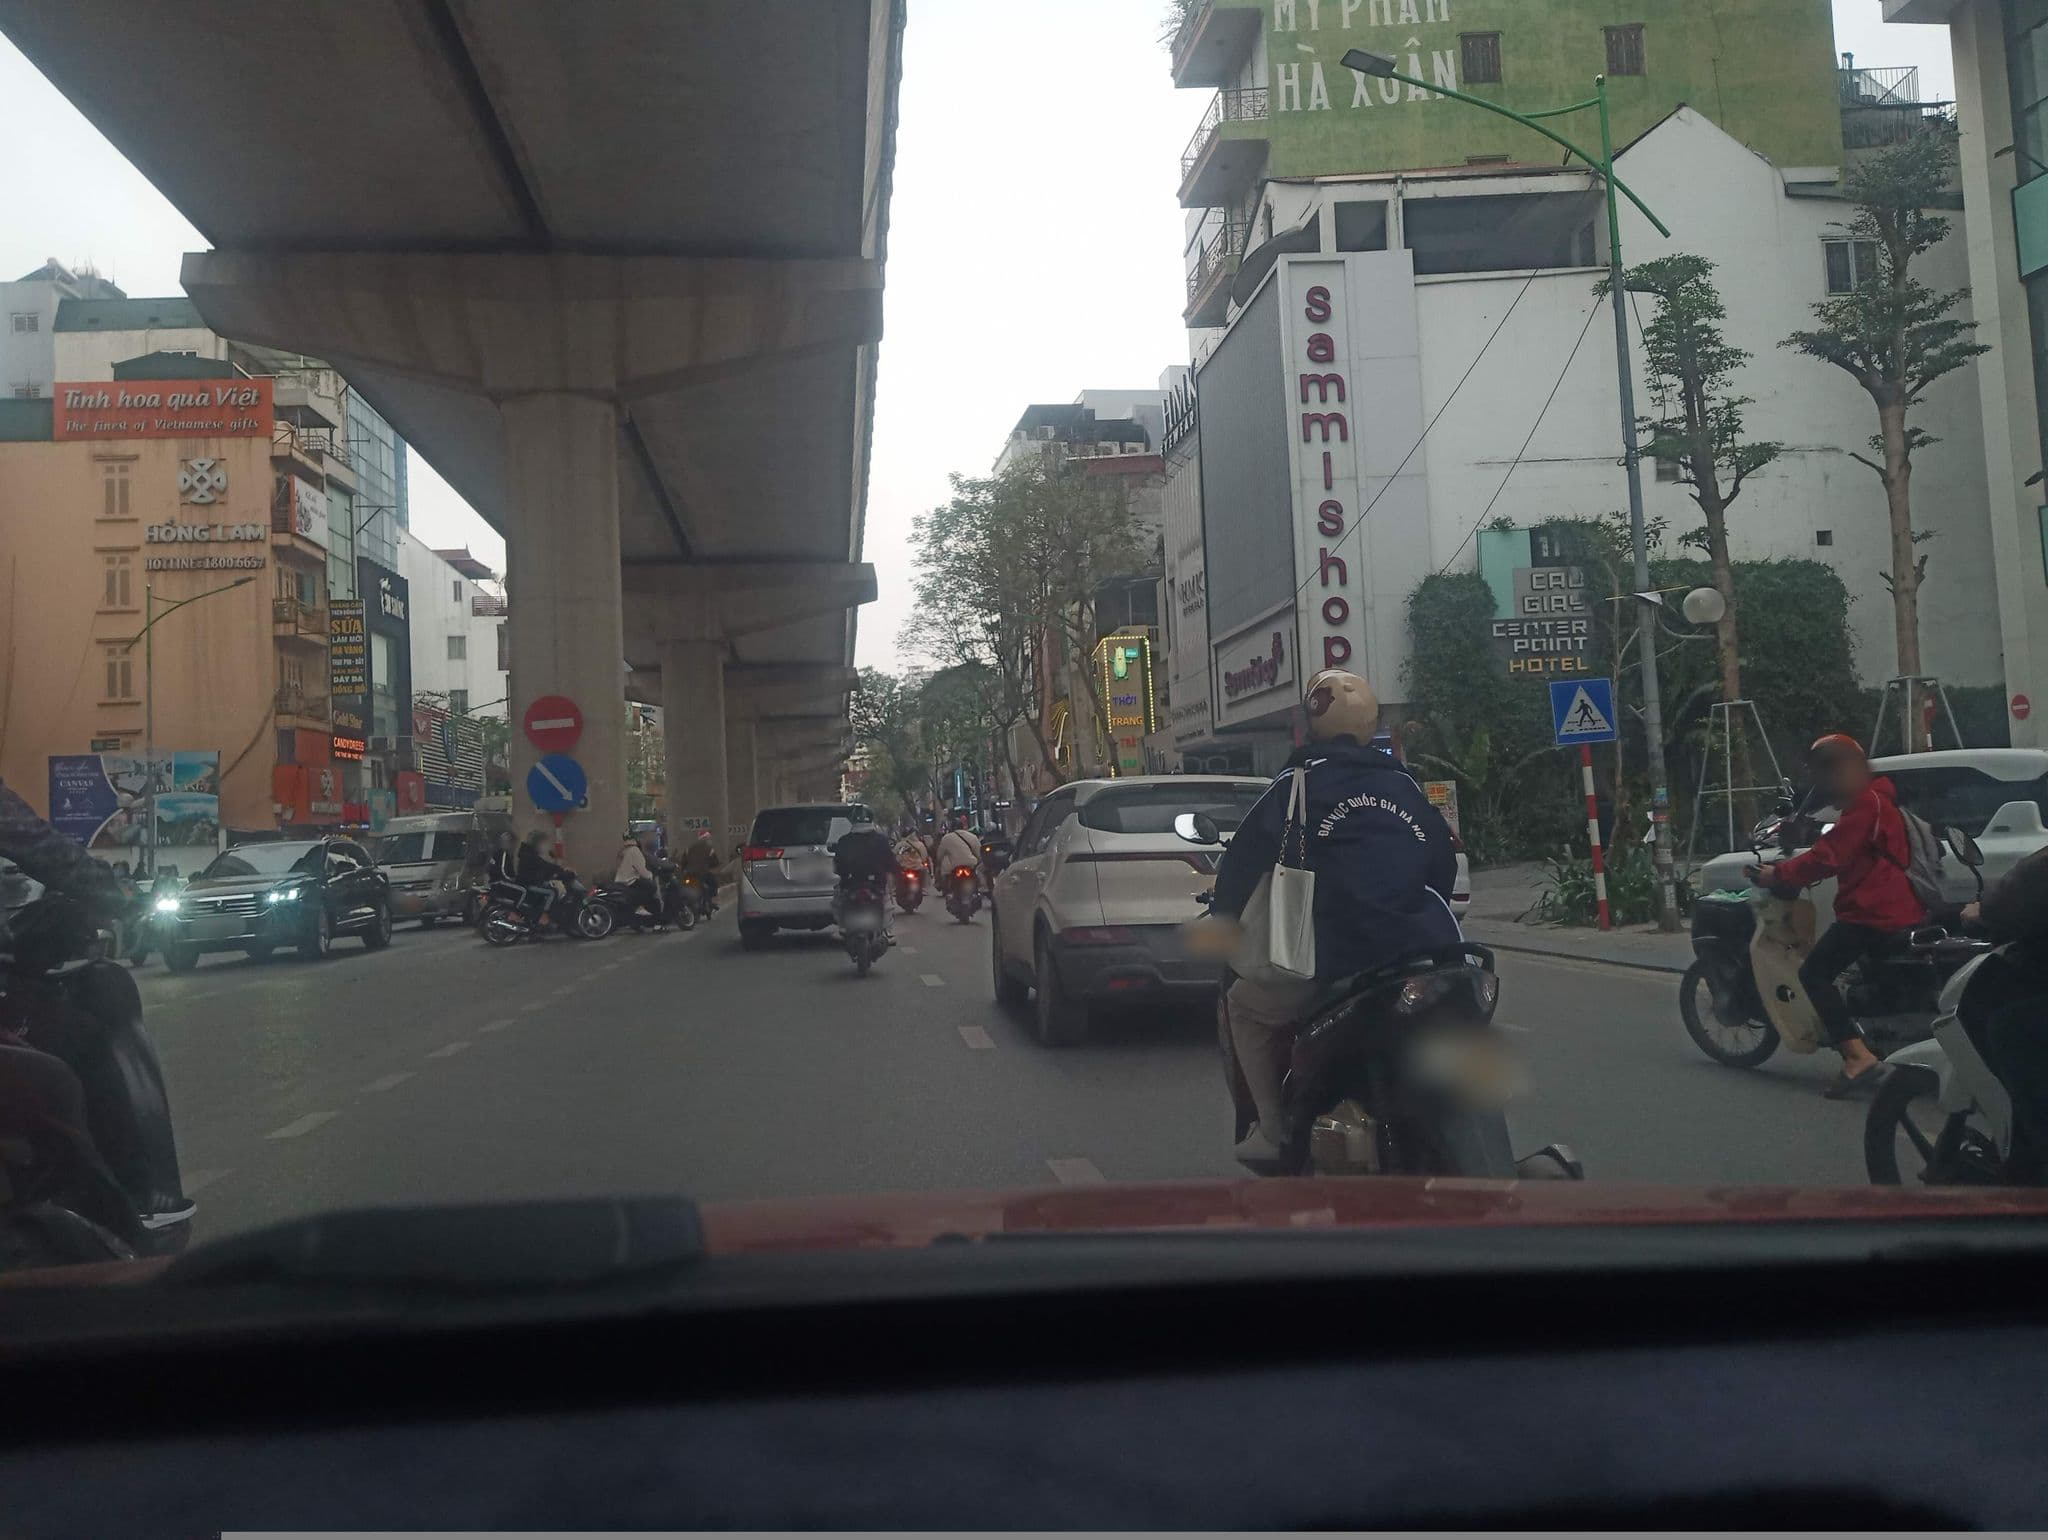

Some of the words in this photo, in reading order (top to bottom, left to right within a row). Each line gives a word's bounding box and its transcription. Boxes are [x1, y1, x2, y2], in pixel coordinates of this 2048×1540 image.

[1276, 43, 1332, 111] HÀ
[1350, 37, 1458, 109] XUÂN
[64, 389, 111, 409] Tinh
[117, 388, 161, 409] hoa
[216, 385, 260, 410] Việt
[1161, 358, 1197, 434] HMK
[65, 420, 87, 432] The
[94, 420, 128, 433] finest
[134, 420, 147, 433] of
[155, 419, 224, 430] Vietnamese
[230, 417, 259, 432] gifts
[1160, 409, 1195, 458] EYEWEAR
[216, 523, 266, 542] LAM
[1492, 620, 1588, 637] CENTER
[1513, 637, 1589, 653] POINT
[1509, 657, 1591, 674] HOTEL
[1111, 716, 1144, 726] TRANG
[60, 778, 94, 788] CANVAS
[1317, 819, 1335, 837] ĐẠI
[1328, 802, 1350, 822] HỌC
[1347, 793, 1377, 808] QUỐC
[1380, 799, 1398, 814] GIA
